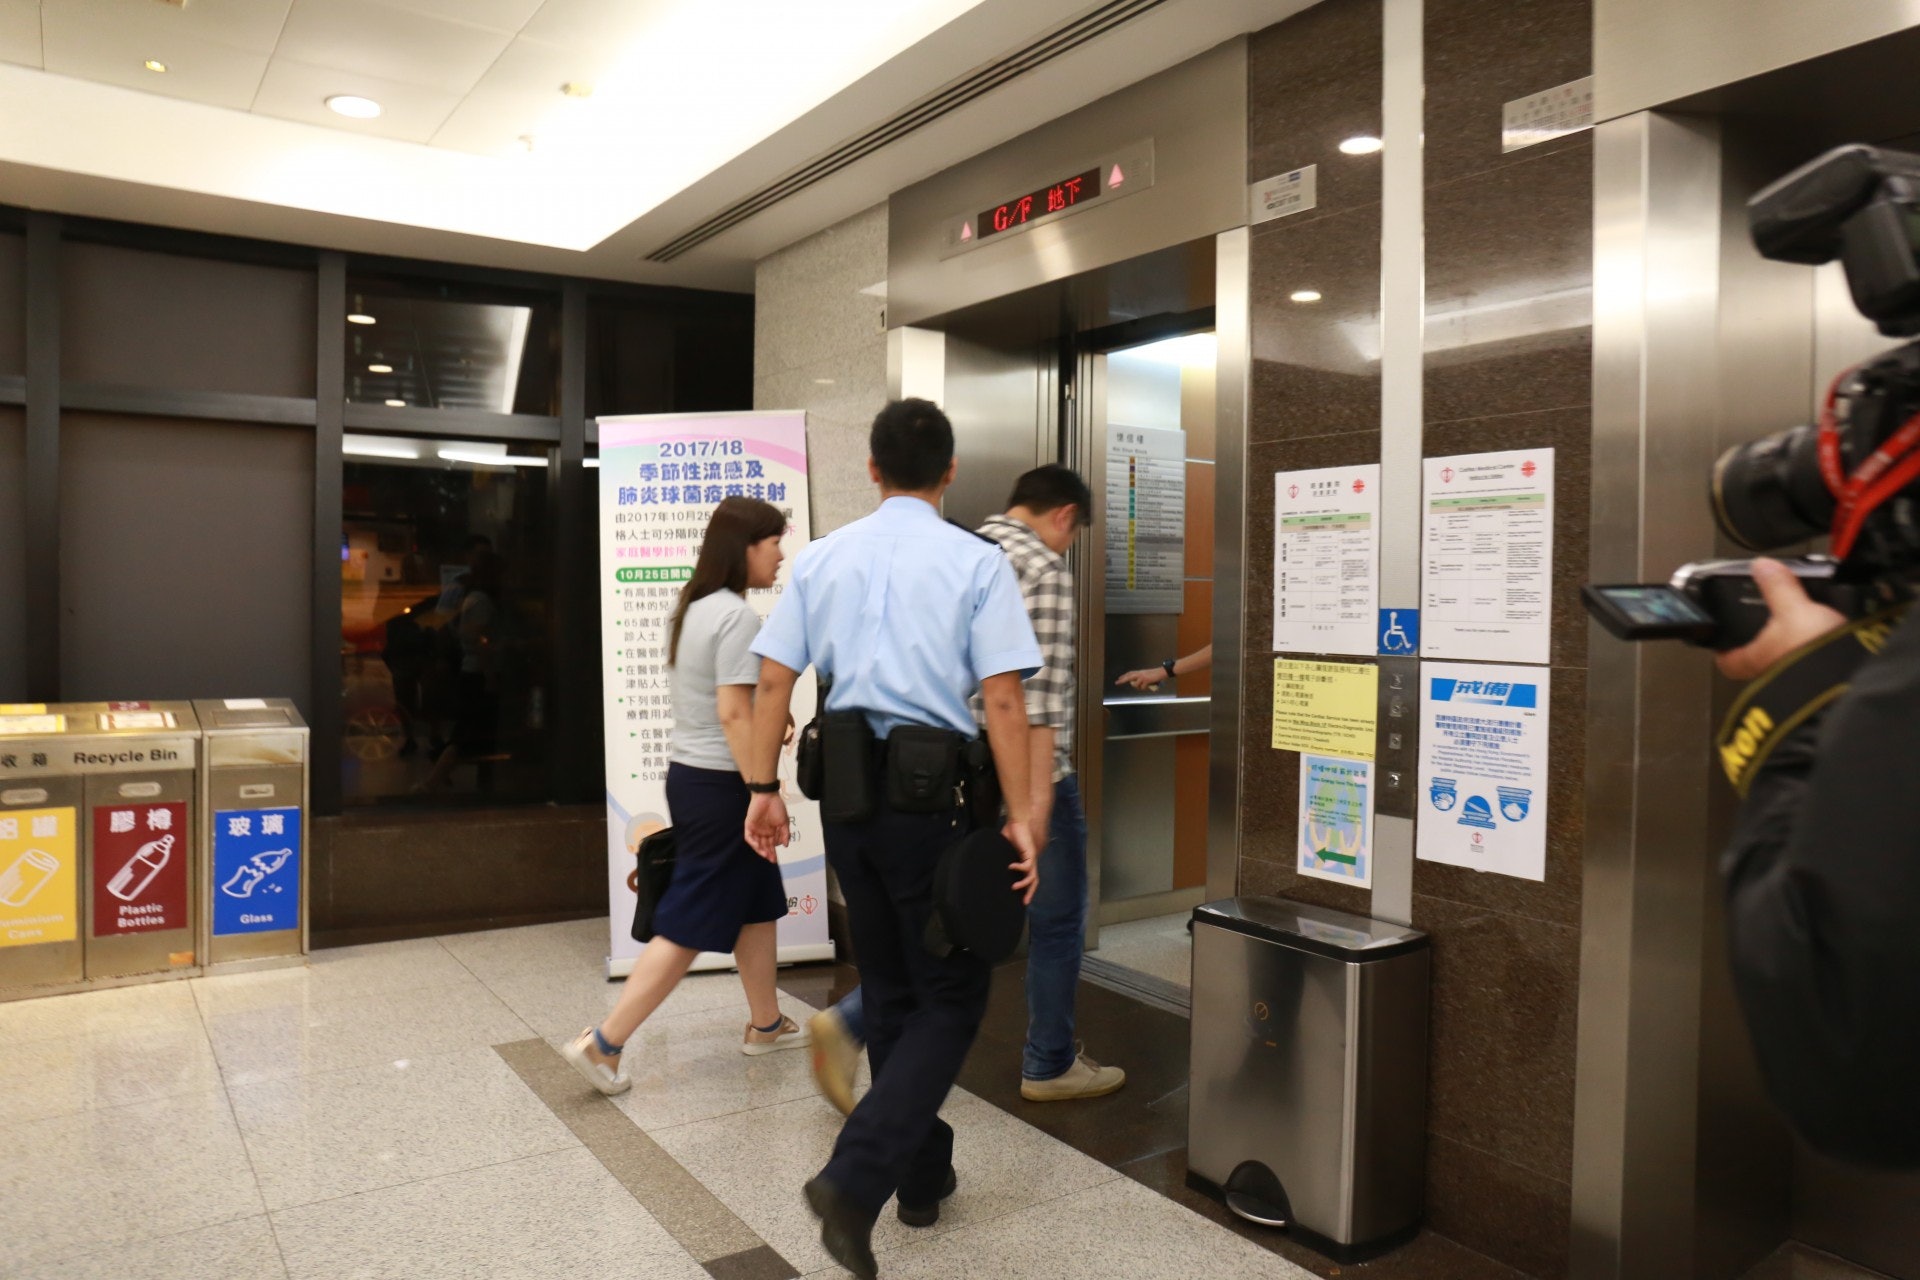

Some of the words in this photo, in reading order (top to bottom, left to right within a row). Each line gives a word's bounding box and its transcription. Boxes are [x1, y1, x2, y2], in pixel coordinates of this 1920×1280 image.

[993, 196, 1033, 232] G/F
[1048, 178, 1082, 212] 地下
[659, 440, 743, 458] 2017/18
[640, 460, 765, 481] 季節性流感及
[618, 482, 786, 505] 肺炎球菌疫苗注射
[620, 568, 692, 580] 10月25日開始
[1456, 680, 1511, 696] 戒備
[74, 750, 144, 766] Recycle
[151, 748, 178, 761] Bin
[110, 808, 172, 833] 膠樽
[228, 814, 284, 837] 玻璃
[119, 903, 163, 916] Plastic
[240, 913, 273, 924] Glass
[117, 915, 165, 929] Bottles
